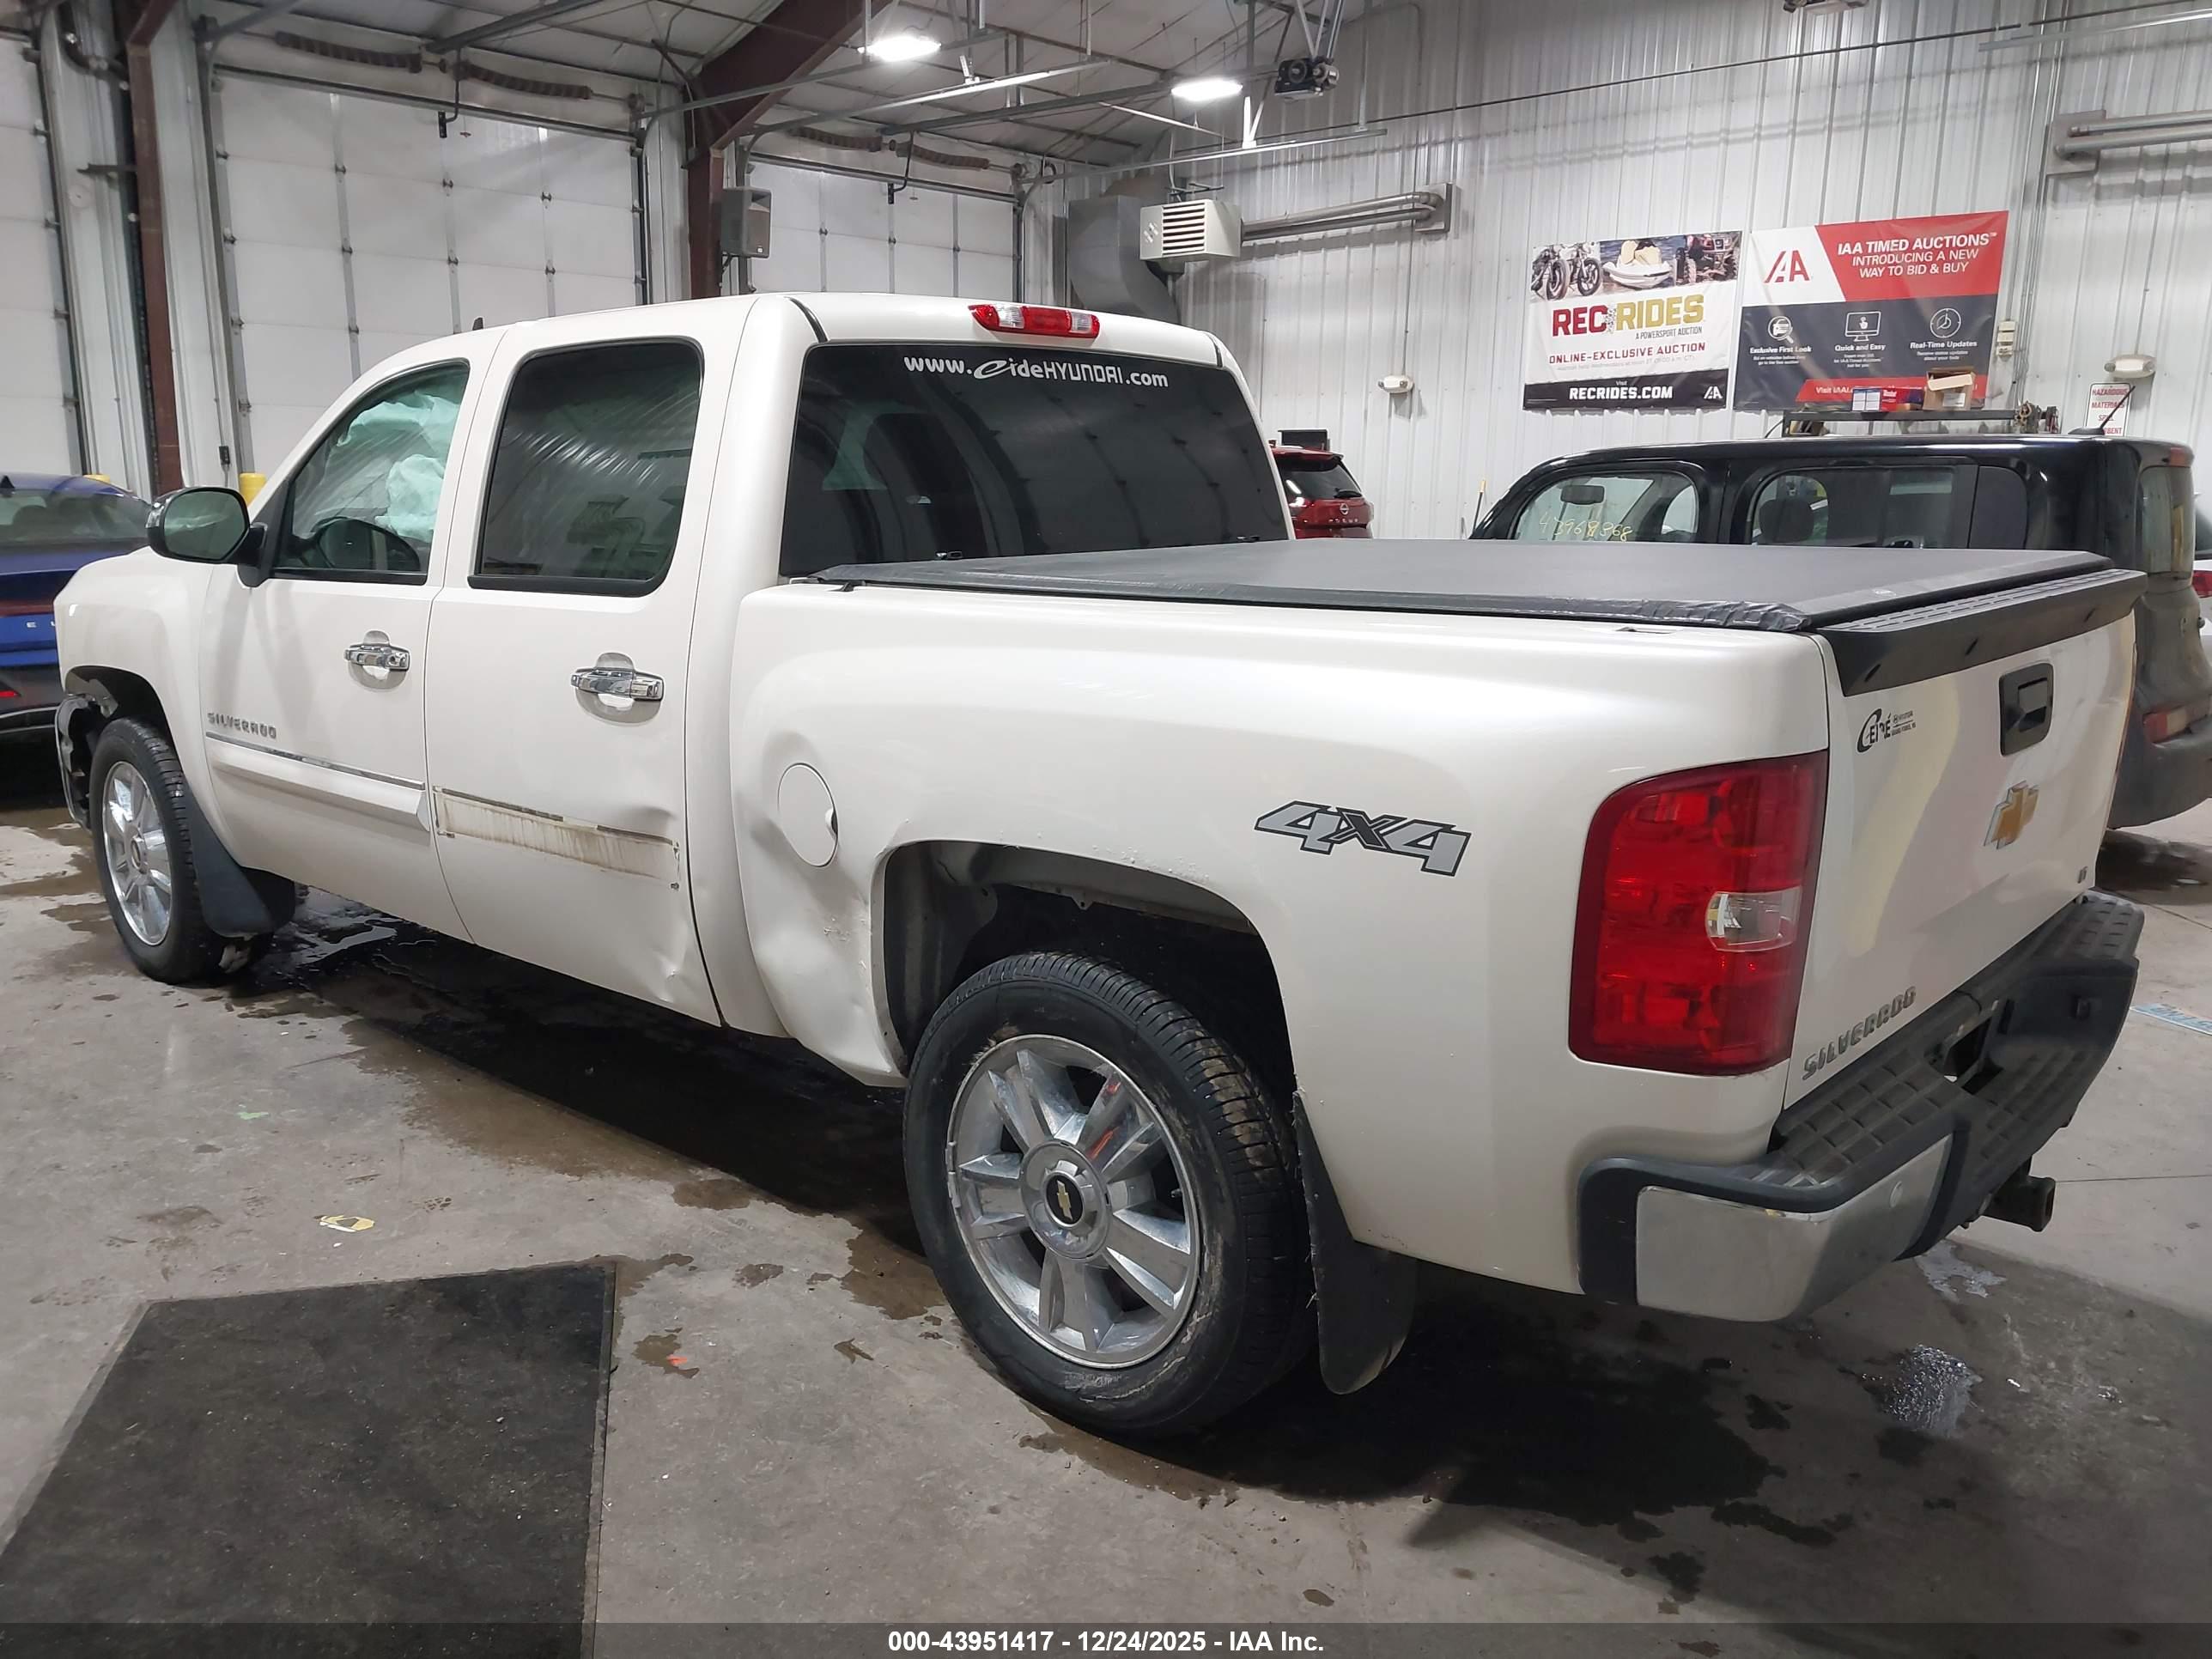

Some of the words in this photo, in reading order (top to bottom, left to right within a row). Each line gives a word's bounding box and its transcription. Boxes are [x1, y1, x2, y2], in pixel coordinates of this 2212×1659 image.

[1838, 241, 1863, 255] IAA
[1866, 239, 1910, 253] TIMED
[1852, 251, 1933, 266] INTRODUCING
[1936, 250, 1946, 261] A
[1949, 249, 1978, 260] NEW
[1859, 266, 1885, 278] WAY
[1888, 265, 1904, 276] TO
[1906, 264, 1928, 276] BID
[1929, 263, 1939, 274] &
[1942, 261, 1969, 273] BUY
[1552, 304, 1609, 337] REC
[1615, 294, 1705, 331] RIDES
[1640, 328, 1677, 340] POWERSPORT
[1678, 325, 1703, 336] AUCTION
[1548, 347, 1654, 364] ONLINE-EXCLUSIVE
[1656, 342, 1706, 356] AUCTION
[1569, 386, 1674, 401] RECRIDES.COM
[1815, 386, 1832, 394] Visit
[207, 712, 277, 739] SILVERADO
[1802, 986, 1917, 1080] SILVERADO
